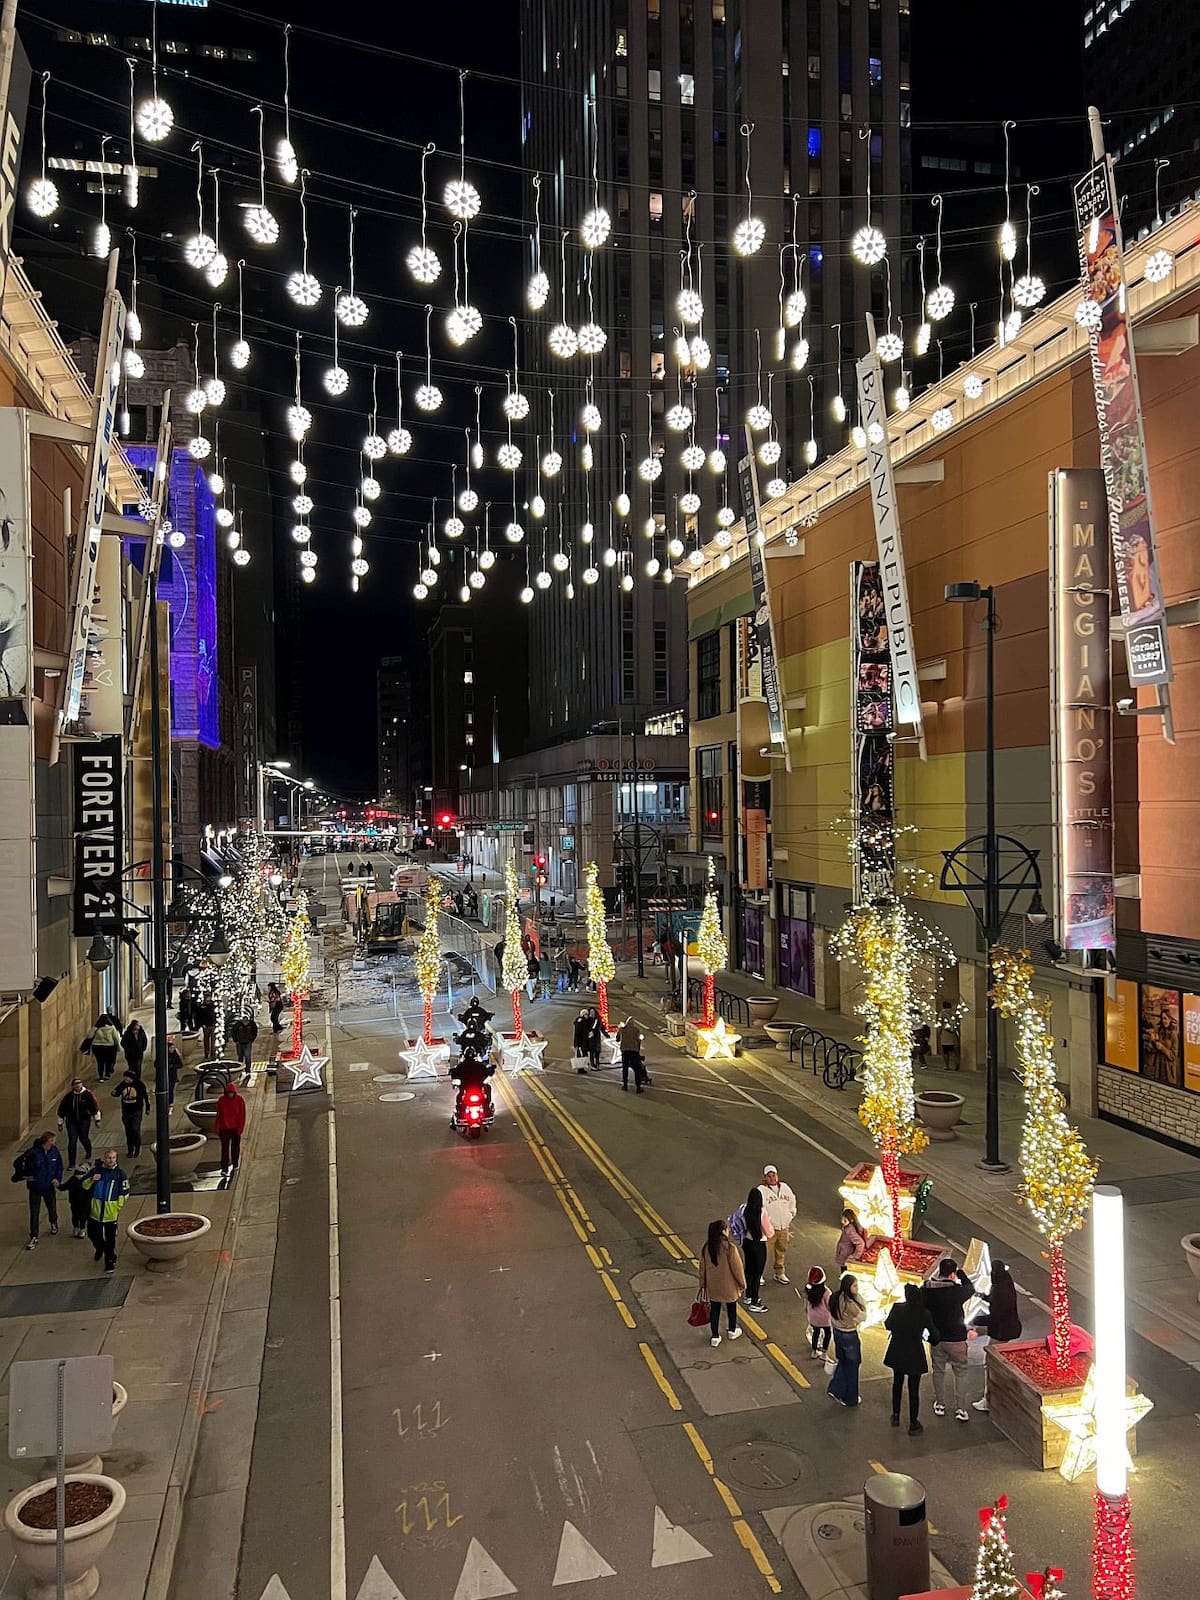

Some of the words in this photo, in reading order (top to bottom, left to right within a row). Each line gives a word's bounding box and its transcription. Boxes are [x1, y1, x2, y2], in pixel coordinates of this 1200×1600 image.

[1077, 179, 1105, 206] corner
[1079, 190, 1106, 216] bakery
[1087, 321, 1113, 431] Sandwiches
[1099, 431, 1118, 496] SALADS
[861, 371, 891, 526] BAANA
[881, 535, 915, 707] REPUBLIC
[1106, 496, 1126, 562] Panini
[1114, 560, 1132, 627] SWEETS
[1072, 523, 1104, 795] MAGGIANO'S
[1131, 640, 1160, 653] corner
[81, 755, 115, 878] FOREVER
[1067, 807, 1110, 817] LITTLE
[83, 892, 116, 919] 21
